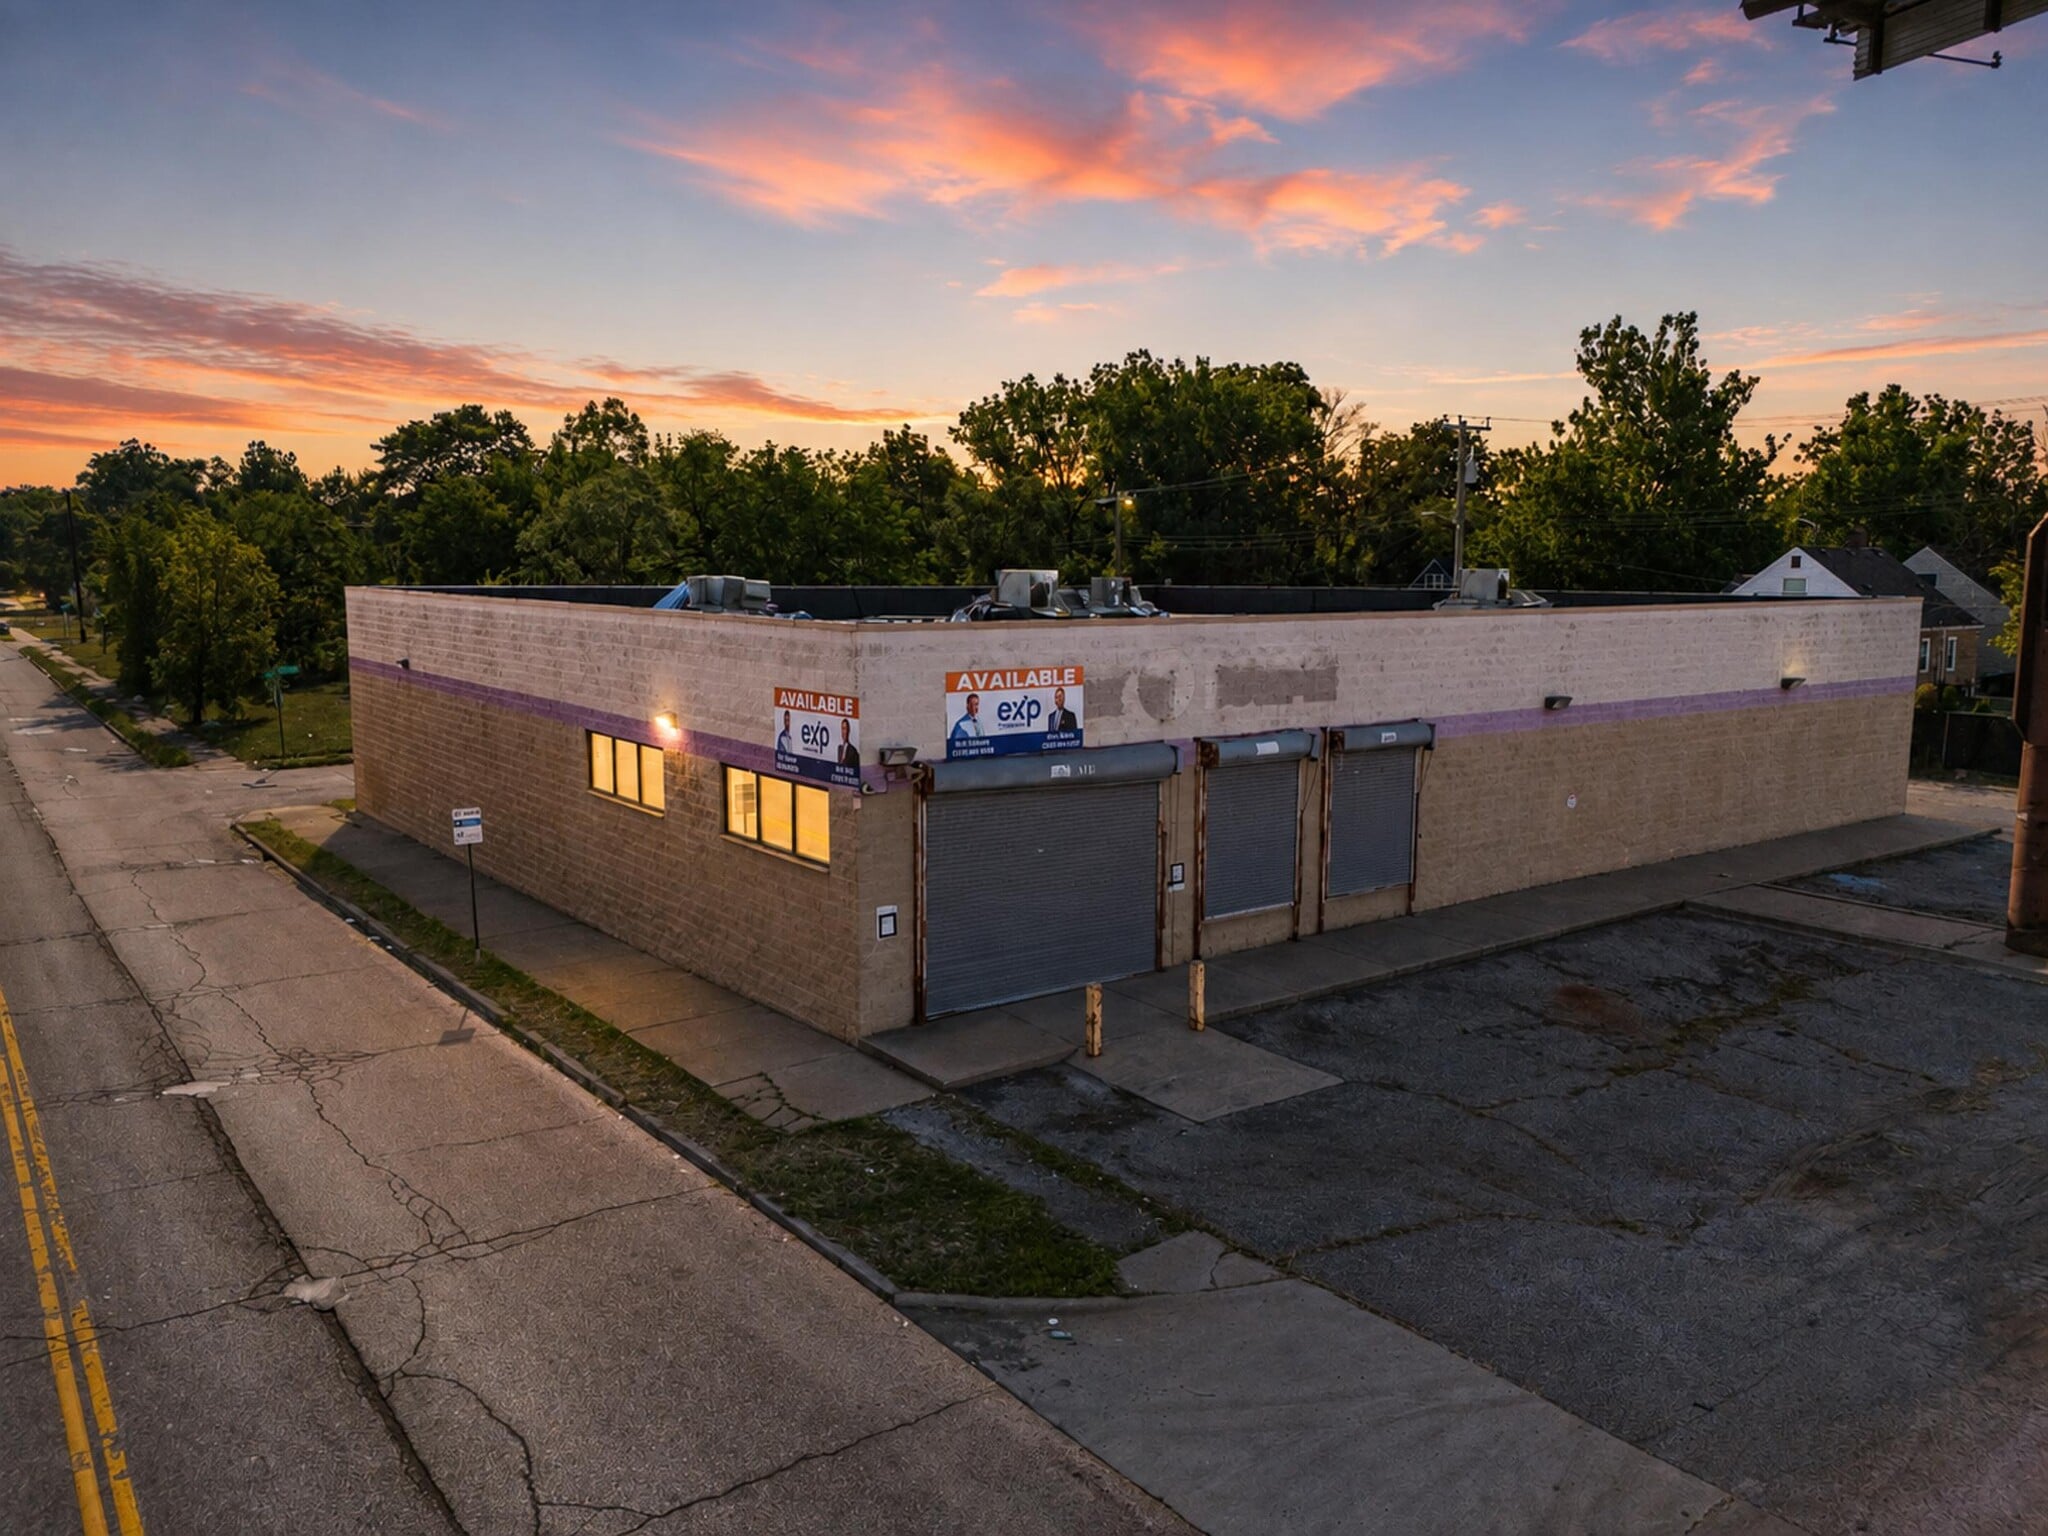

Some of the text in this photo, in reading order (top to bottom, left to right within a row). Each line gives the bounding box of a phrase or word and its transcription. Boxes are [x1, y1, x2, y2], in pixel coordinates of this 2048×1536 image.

[956, 667, 1076, 691] AVAILABLE
[779, 690, 854, 716] AVAILABLE
[997, 695, 1042, 728] exp
[801, 721, 830, 754] exp
